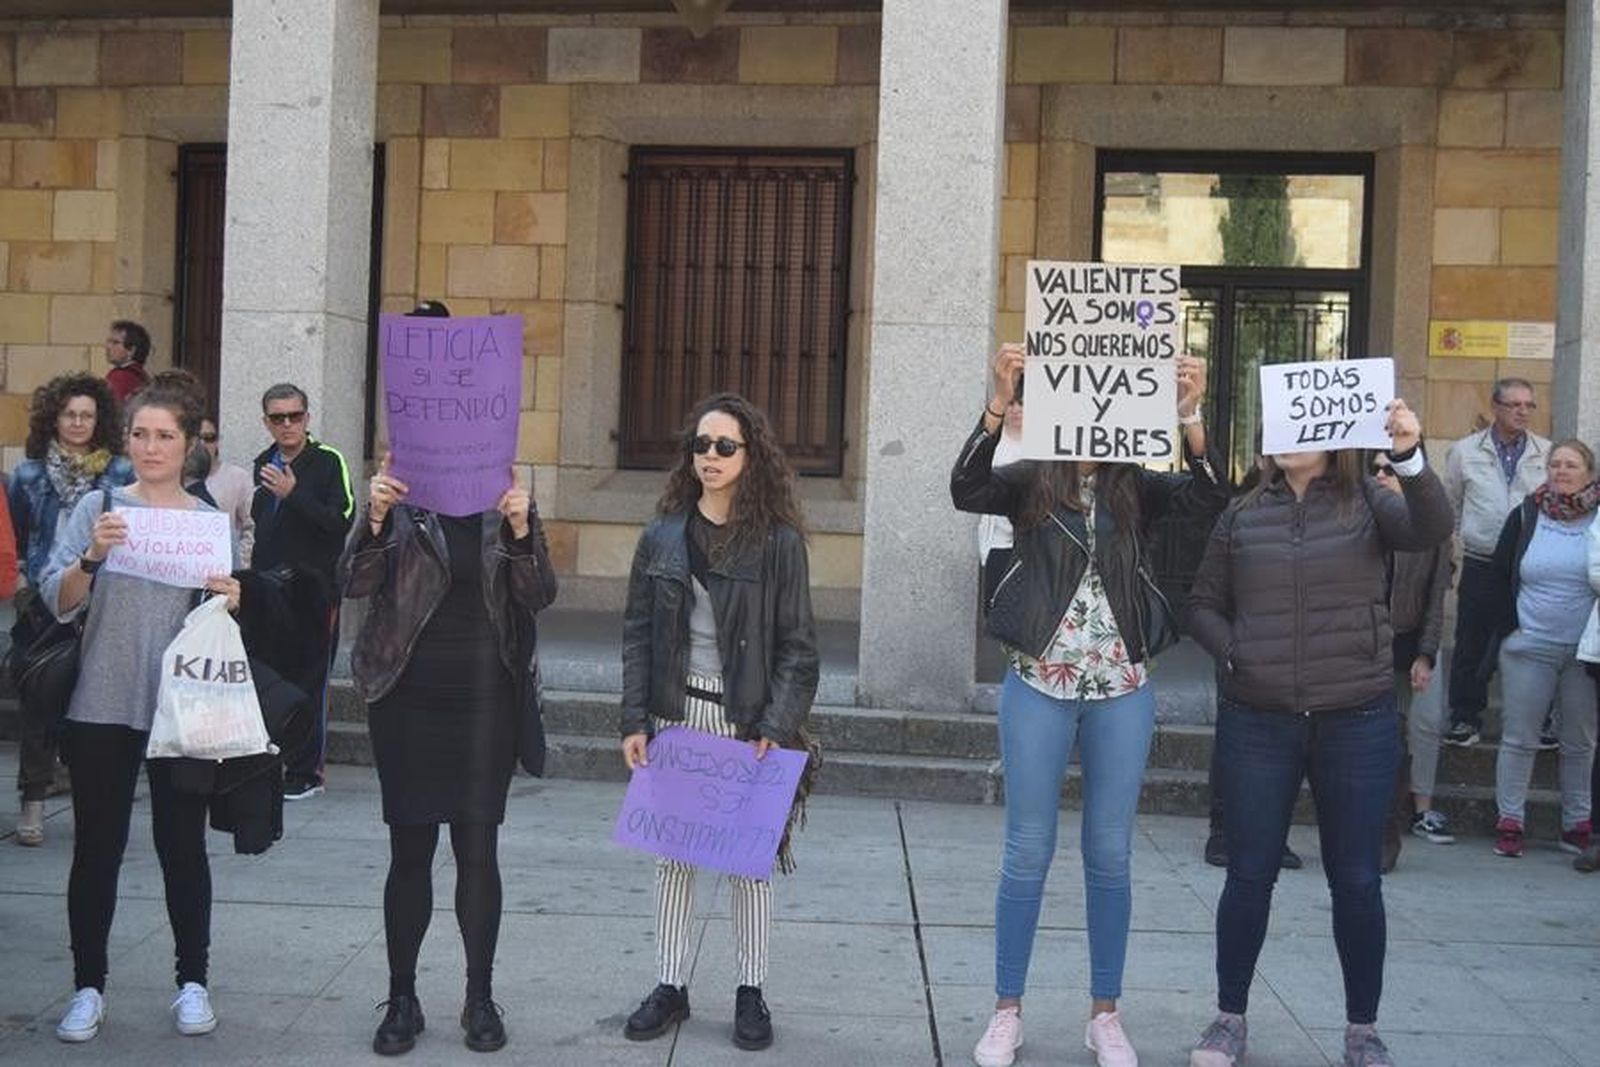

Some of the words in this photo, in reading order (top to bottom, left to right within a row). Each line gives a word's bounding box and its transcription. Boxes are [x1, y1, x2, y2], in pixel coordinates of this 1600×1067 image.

[1034, 267, 1179, 294] VALIENTES
[1042, 298, 1078, 326] YA
[386, 323, 502, 362] LETICIA
[1027, 331, 1067, 356] NOS
[1072, 333, 1175, 359] QUEREMOS
[1044, 364, 1159, 397] VIVAS
[1284, 367, 1360, 391] TODAS
[1092, 396, 1112, 422] Y
[1289, 393, 1376, 420] SOMOS
[1054, 425, 1172, 457] LIBRES
[1296, 420, 1356, 444] LETY
